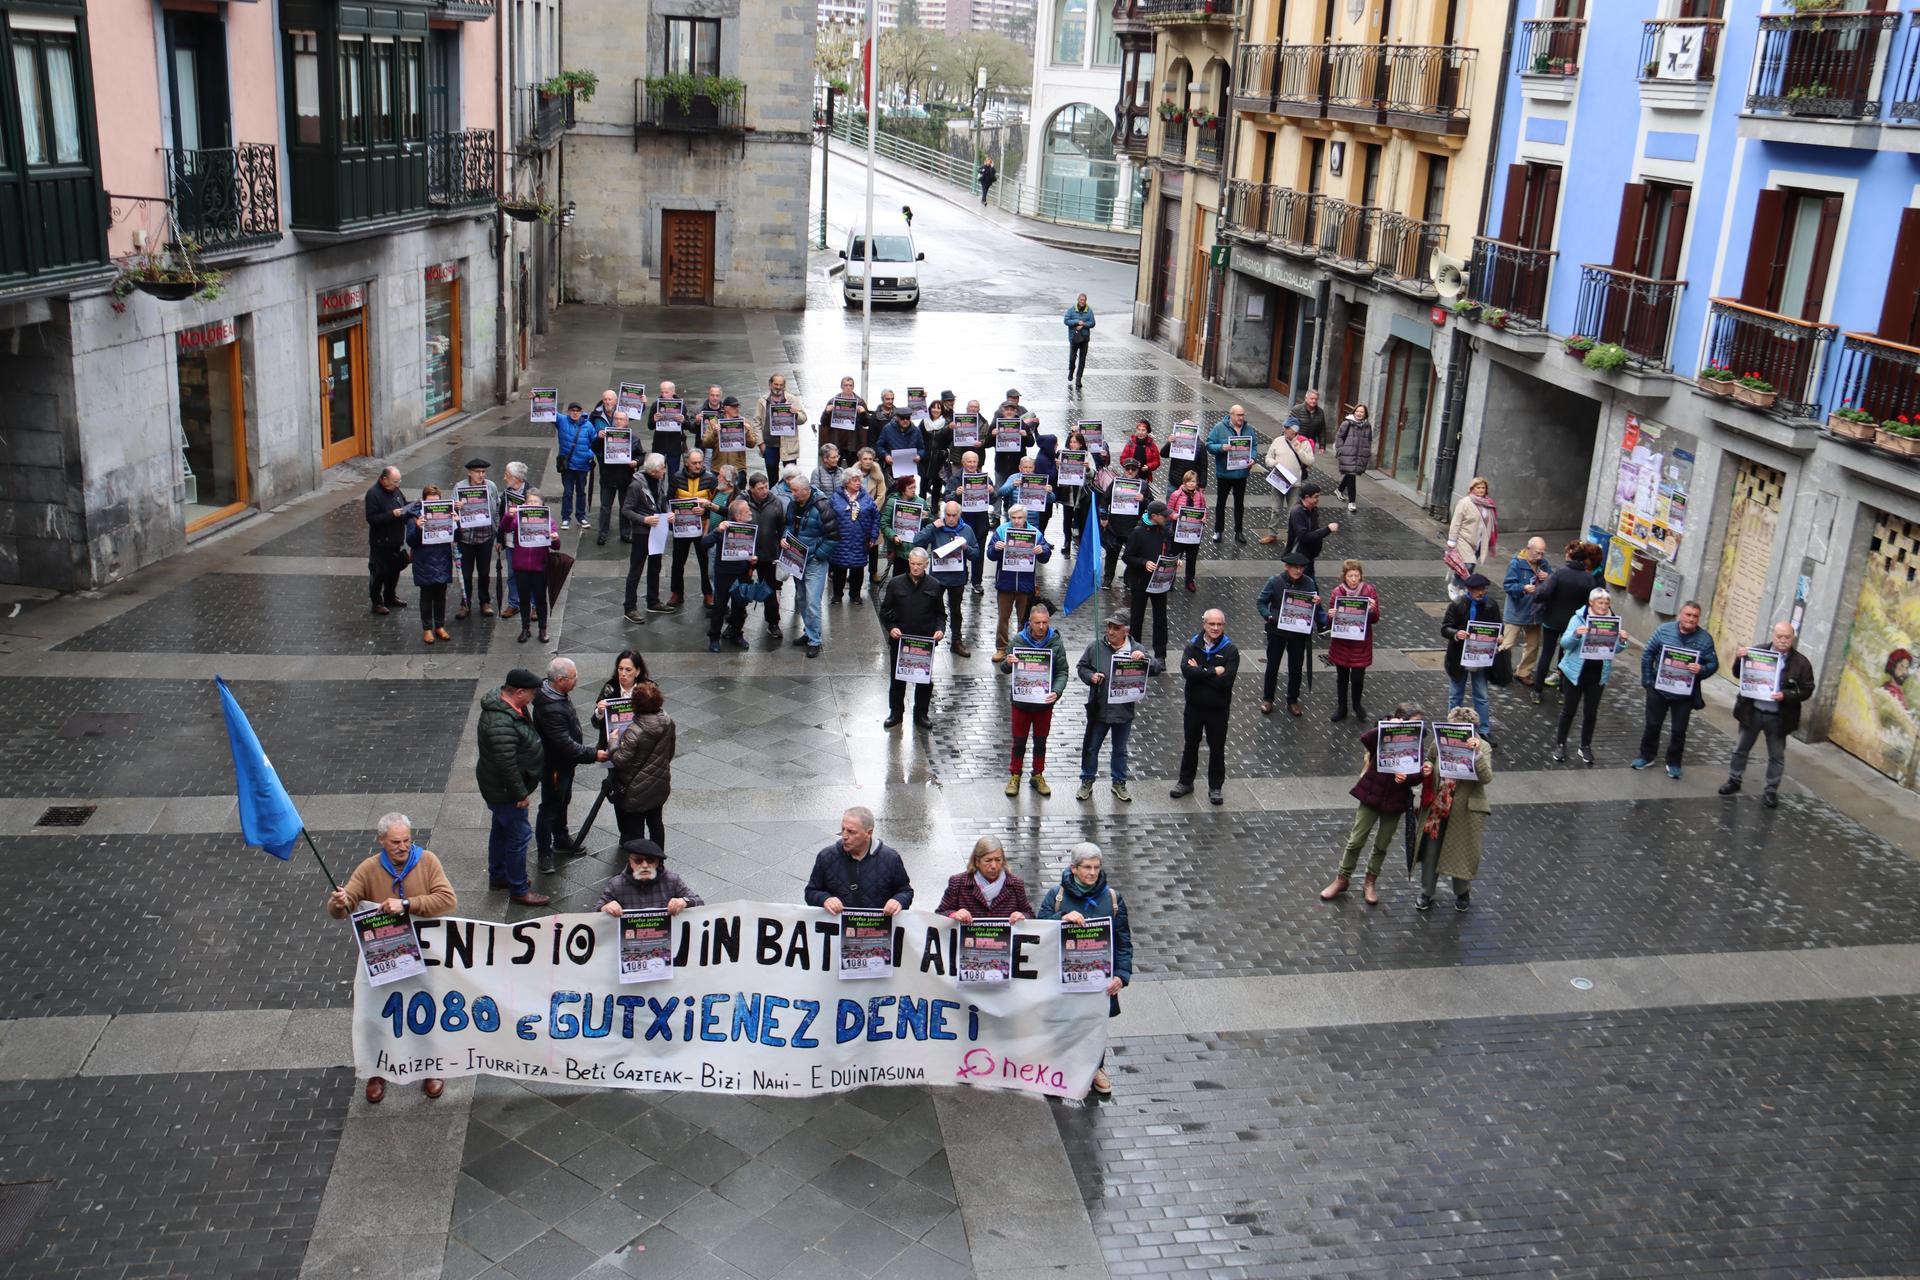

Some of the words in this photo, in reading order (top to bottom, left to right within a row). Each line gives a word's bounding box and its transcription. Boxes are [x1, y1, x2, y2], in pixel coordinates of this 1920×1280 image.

[412, 919, 596, 969] ENTSiO
[373, 959, 397, 973] 1080
[625, 961, 648, 971] 1080
[846, 958, 868, 968] 1080
[964, 970, 986, 979] 1080
[1066, 972, 1088, 982] 1080
[381, 990, 501, 1038] 1080
[566, 1058, 606, 1080] Beti
[701, 1062, 741, 1090] Bizi
